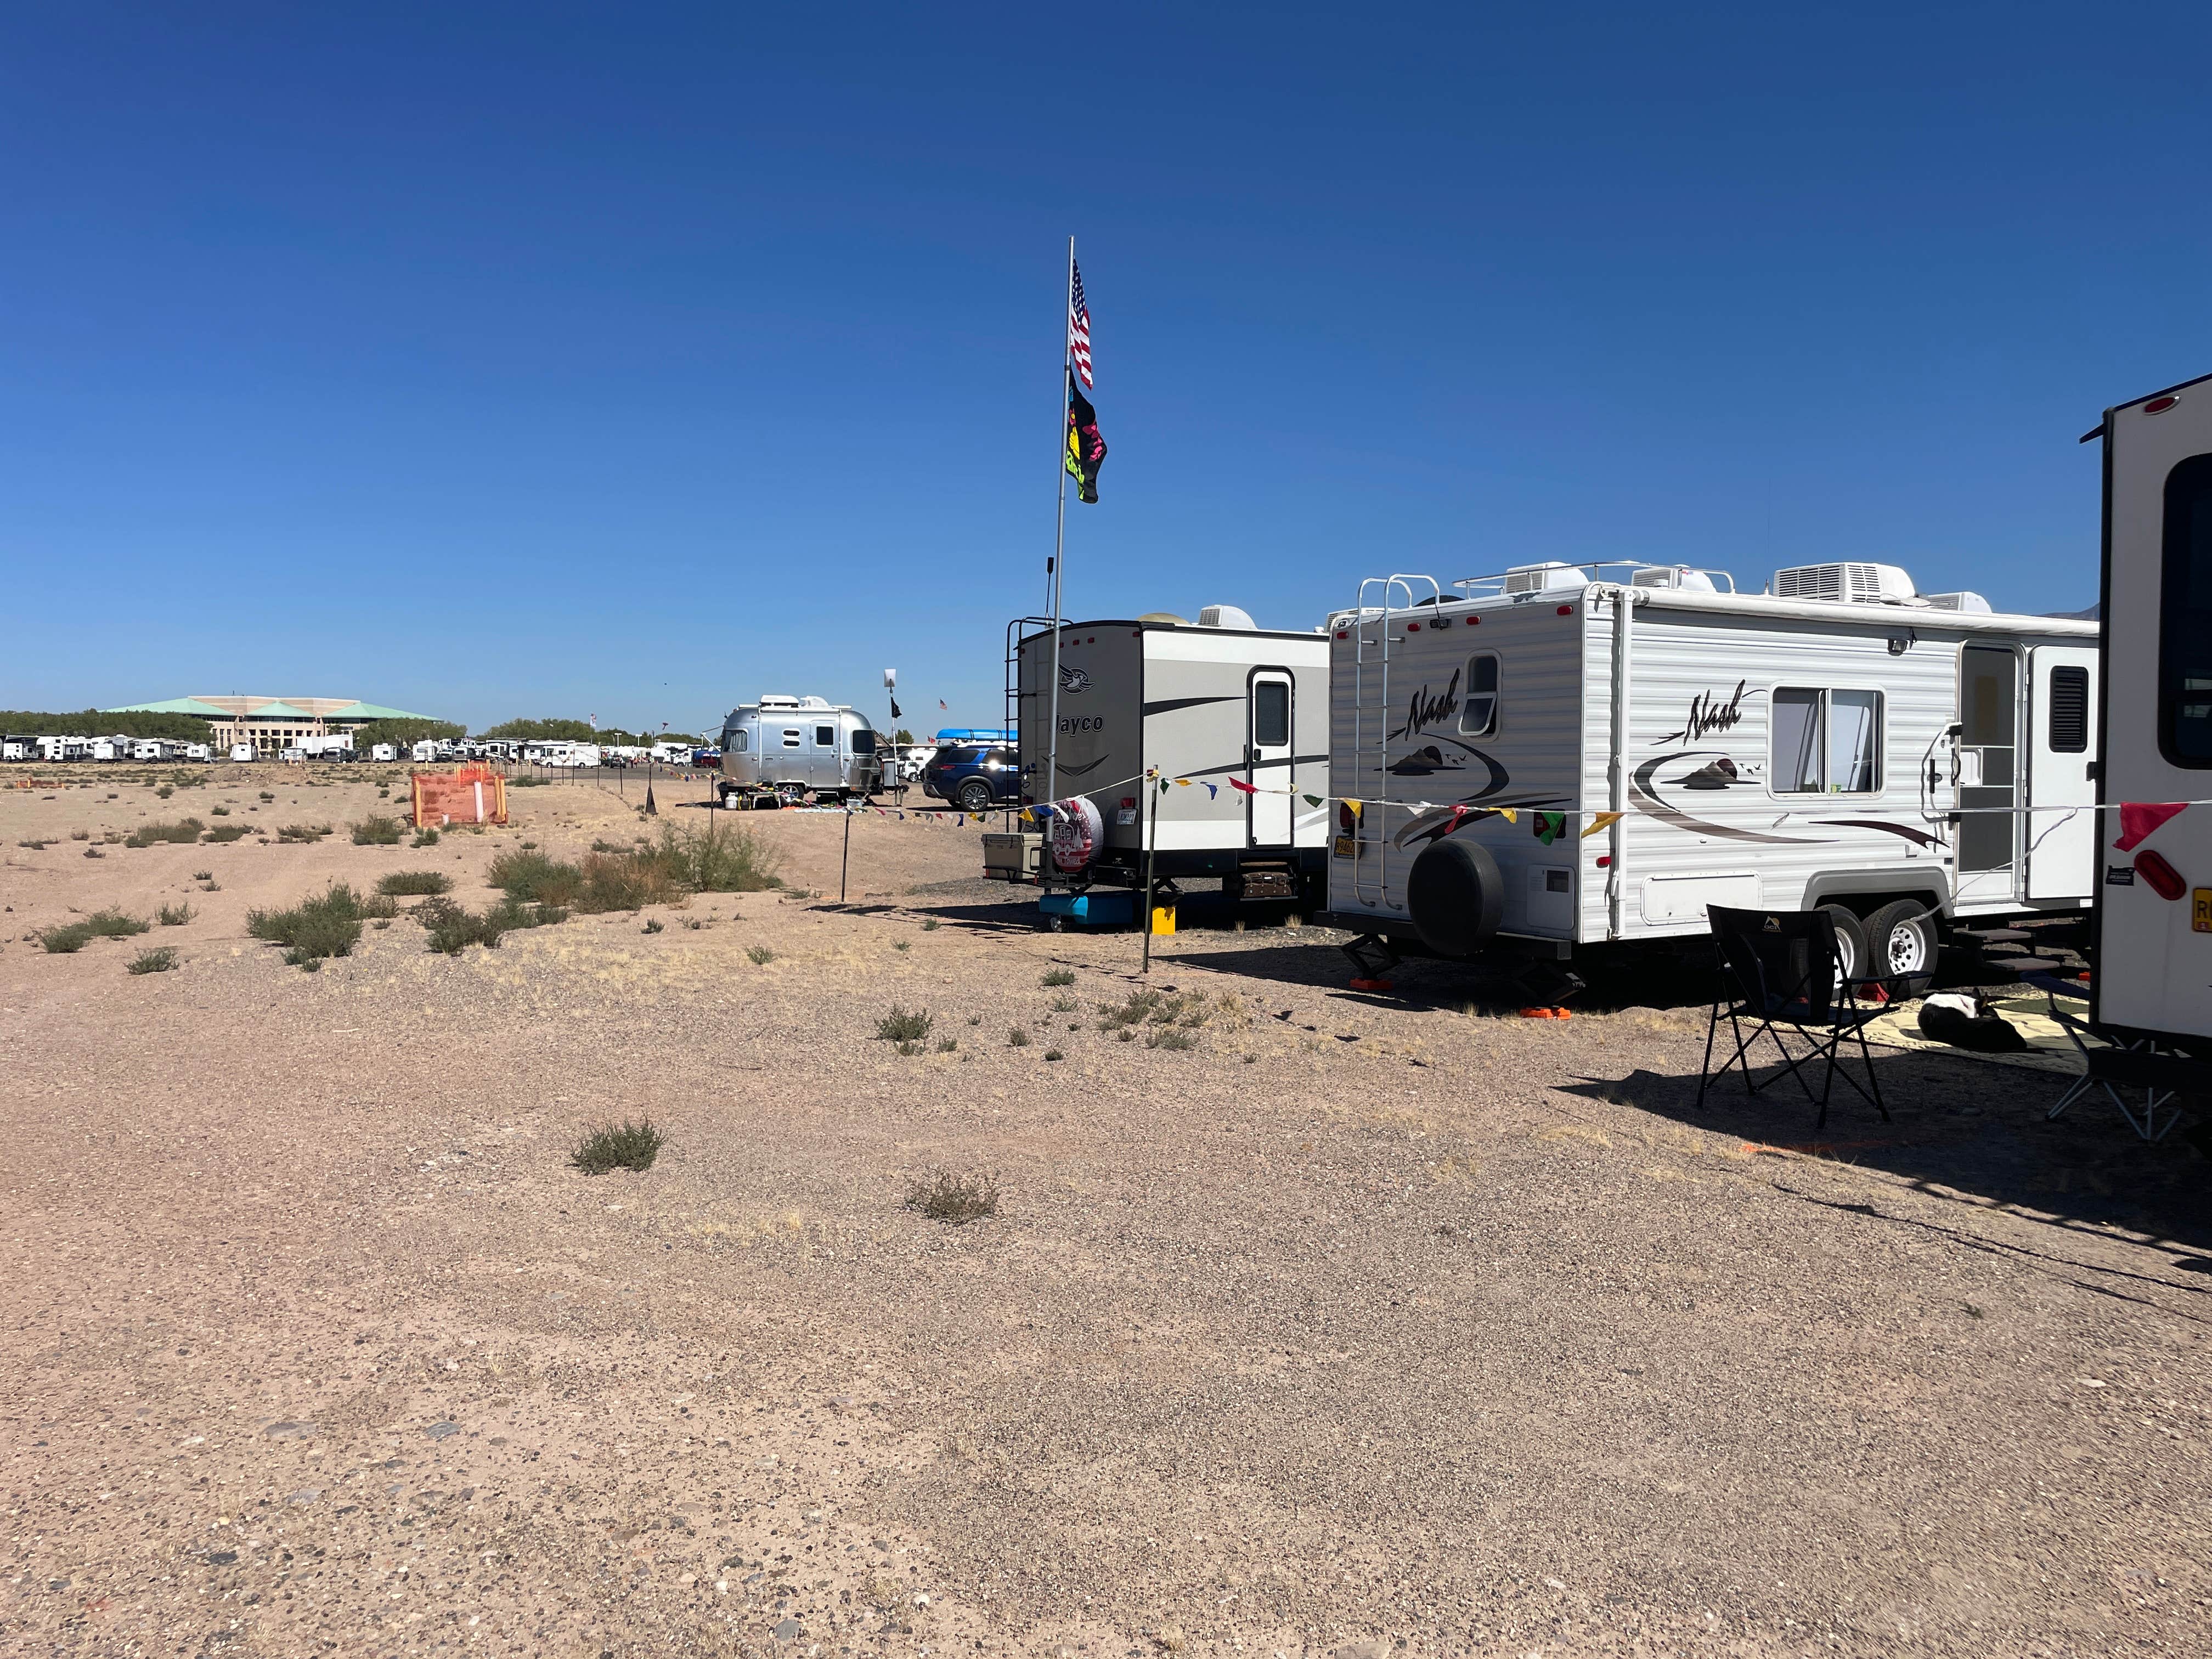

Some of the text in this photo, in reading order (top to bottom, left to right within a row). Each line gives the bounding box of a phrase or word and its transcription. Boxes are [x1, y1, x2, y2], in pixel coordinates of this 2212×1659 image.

[1404, 668, 1460, 741] Nash
[1683, 679, 1745, 746] Nash
[2198, 900, 2212, 919] R
